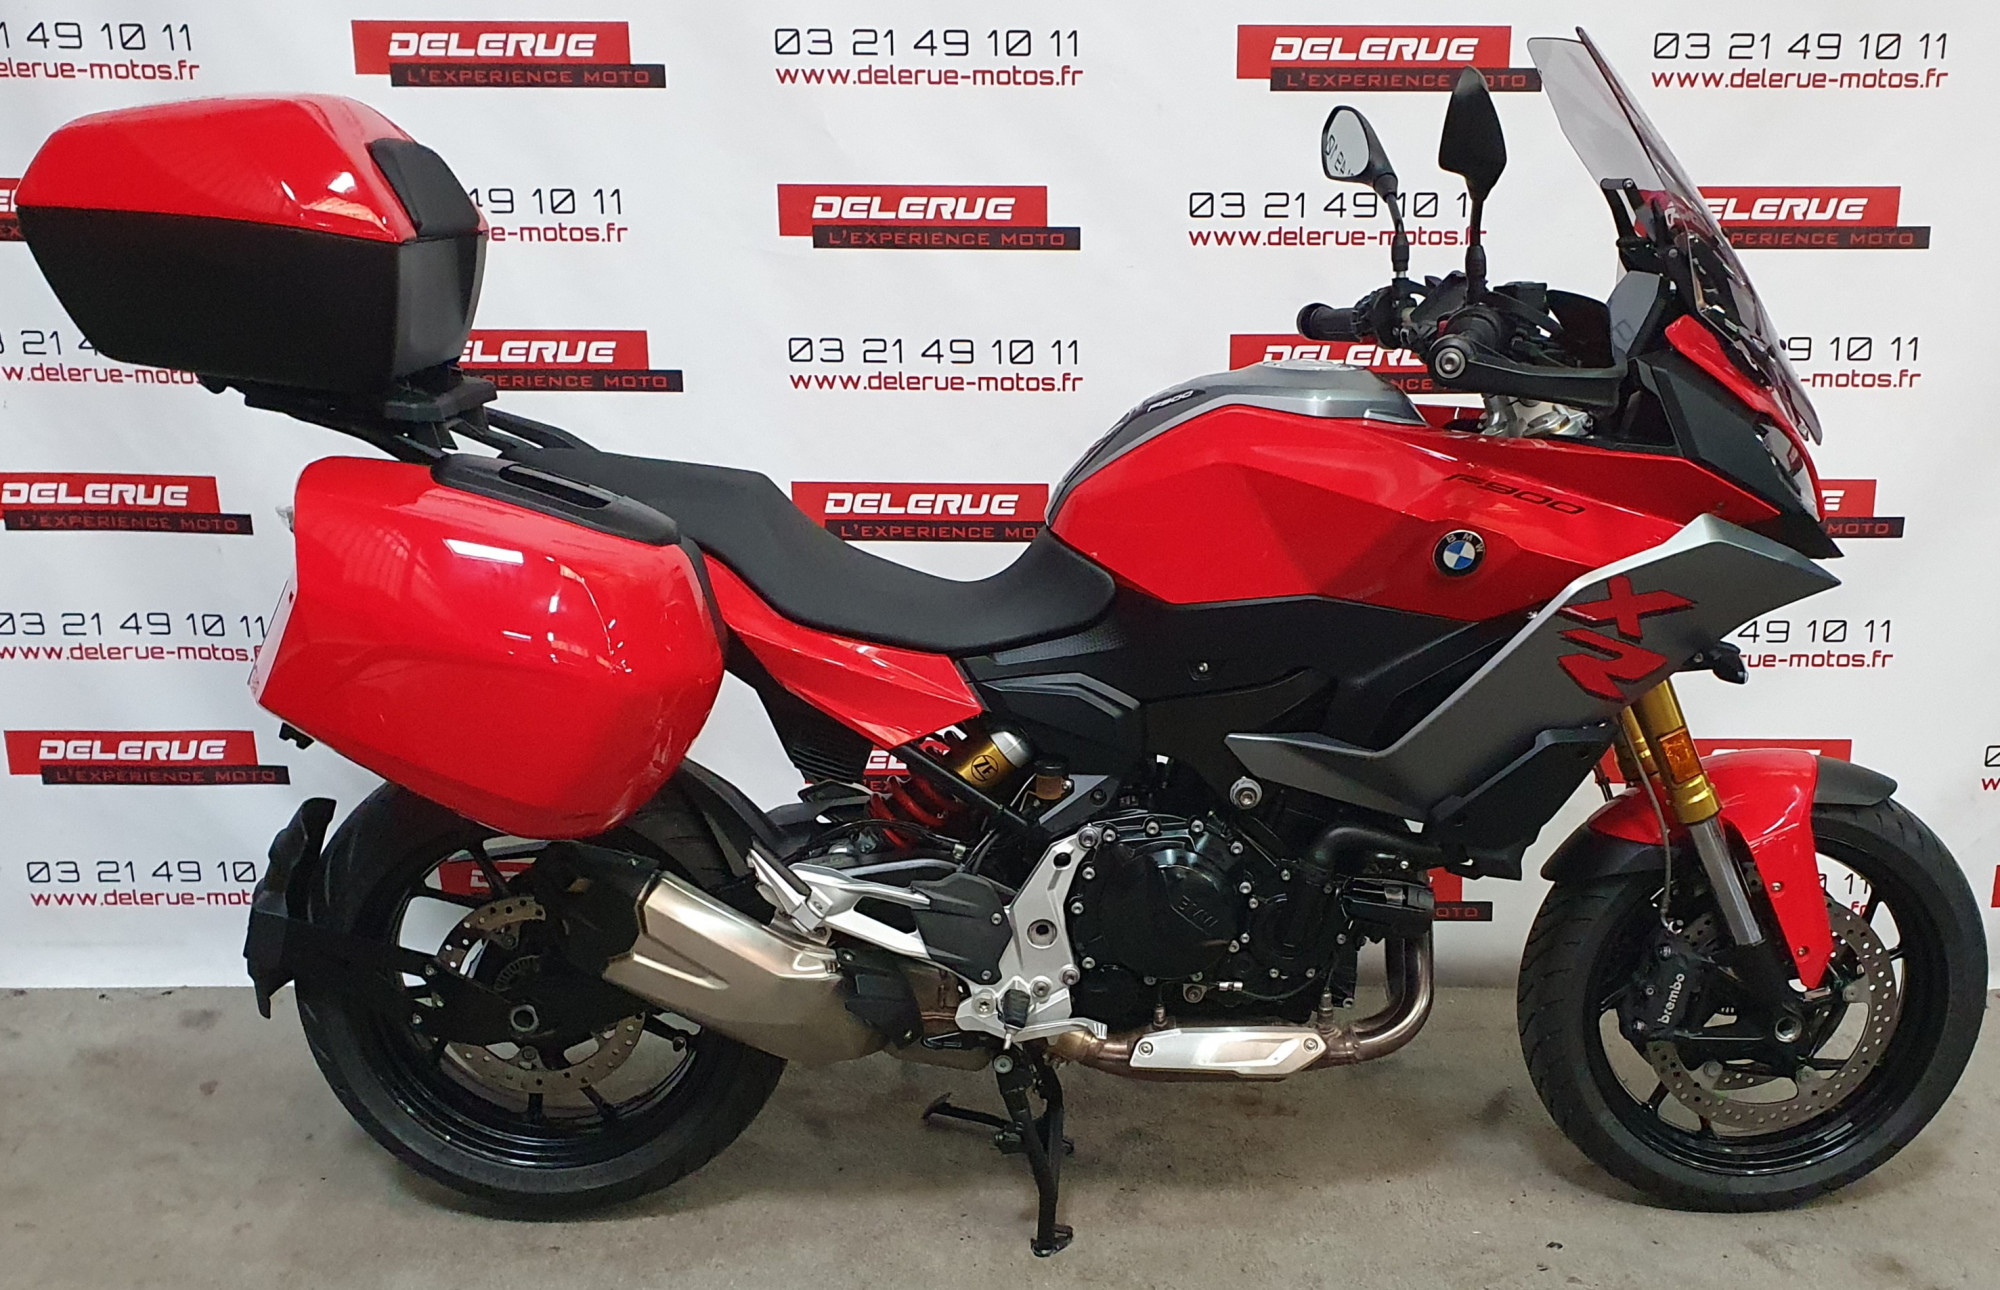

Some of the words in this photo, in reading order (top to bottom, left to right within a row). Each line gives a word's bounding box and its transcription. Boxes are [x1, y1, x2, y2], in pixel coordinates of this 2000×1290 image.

[27, 22, 82, 49] 49
[101, 23, 146, 50] 10
[162, 24, 191, 51] 11
[388, 32, 597, 57] DELERUE
[775, 28, 832, 55] 03
[852, 29, 894, 56] 21
[913, 29, 969, 56] 49
[987, 30, 1031, 57] 10
[1050, 30, 1078, 57] 11
[1654, 32, 1710, 60] 03
[1729, 32, 1771, 60] 21
[1787, 32, 1842, 60] 49
[1859, 32, 1902, 60] 10
[1919, 32, 1948, 60] 11
[1270, 36, 1479, 61] DELERUE
[407, 68, 573, 84] L'EXPERIENCE
[583, 71, 650, 84] MOTO
[775, 64, 1083, 86] www.delerue-motos.fr
[1286, 72, 1450, 87] L'EXPERIENCE
[1485, 74, 1527, 87] OTO
[1651, 68, 1949, 89] www.delerue-motos.fr
[532, 188, 575, 214] 10
[593, 188, 621, 215] 11
[812, 196, 1016, 220] DELERUE
[1189, 192, 1245, 218] 03
[1264, 192, 1305, 218] 21
[1323, 192, 1378, 218] 49
[1395, 192, 1439, 218] 10
[1456, 192, 1468, 218] 1
[1705, 198, 1869, 221] ELERUE
[829, 230, 990, 246] L'EXPERIENCE
[1001, 232, 1065, 246] MOTO
[1850, 232, 1914, 245] MOTO
[21, 331, 61, 355] 21
[78, 337, 99, 356] 4
[458, 340, 617, 363] ELERUE
[788, 337, 844, 363] 03
[863, 338, 903, 363] 21
[921, 339, 974, 364] 49
[992, 339, 1034, 364] 10
[1051, 339, 1078, 365] 11
[1788, 337, 1812, 361] 9
[1829, 337, 1872, 361] 10
[1890, 337, 1919, 361] 11
[604, 375, 667, 388] MOTO
[790, 371, 1083, 392] www.delerue-motos.fr
[2, 482, 189, 506] DELERUE
[824, 492, 1019, 516] DELERUE
[1443, 473, 1586, 515] F900
[19, 515, 175, 529] L'EXPERIENCE
[181, 518, 238, 531] MOTO
[841, 524, 994, 538] L'EXPERIENCE
[1005, 526, 1040, 539] MO
[1827, 523, 1889, 534] MOTO
[0, 612, 45, 636] 03
[61, 612, 102, 636] 21
[119, 612, 171, 636] 49
[186, 613, 225, 637] 10
[240, 615, 266, 638] 11
[1737, 620, 1790, 643] 49
[1807, 620, 1847, 643] 10
[1864, 620, 1891, 643] 11
[39, 739, 227, 761] DELERUE
[56, 768, 205, 782] L'EXPERIENCE
[215, 770, 275, 782] MOTO
[26, 861, 80, 883] 03
[96, 861, 136, 883] 21
[152, 861, 201, 883] 49
[217, 861, 257, 883] 10
[30, 889, 253, 906] www.delerue-mot
[1436, 907, 1478, 917] OTO
[1657, 973, 1686, 1024] brembo
